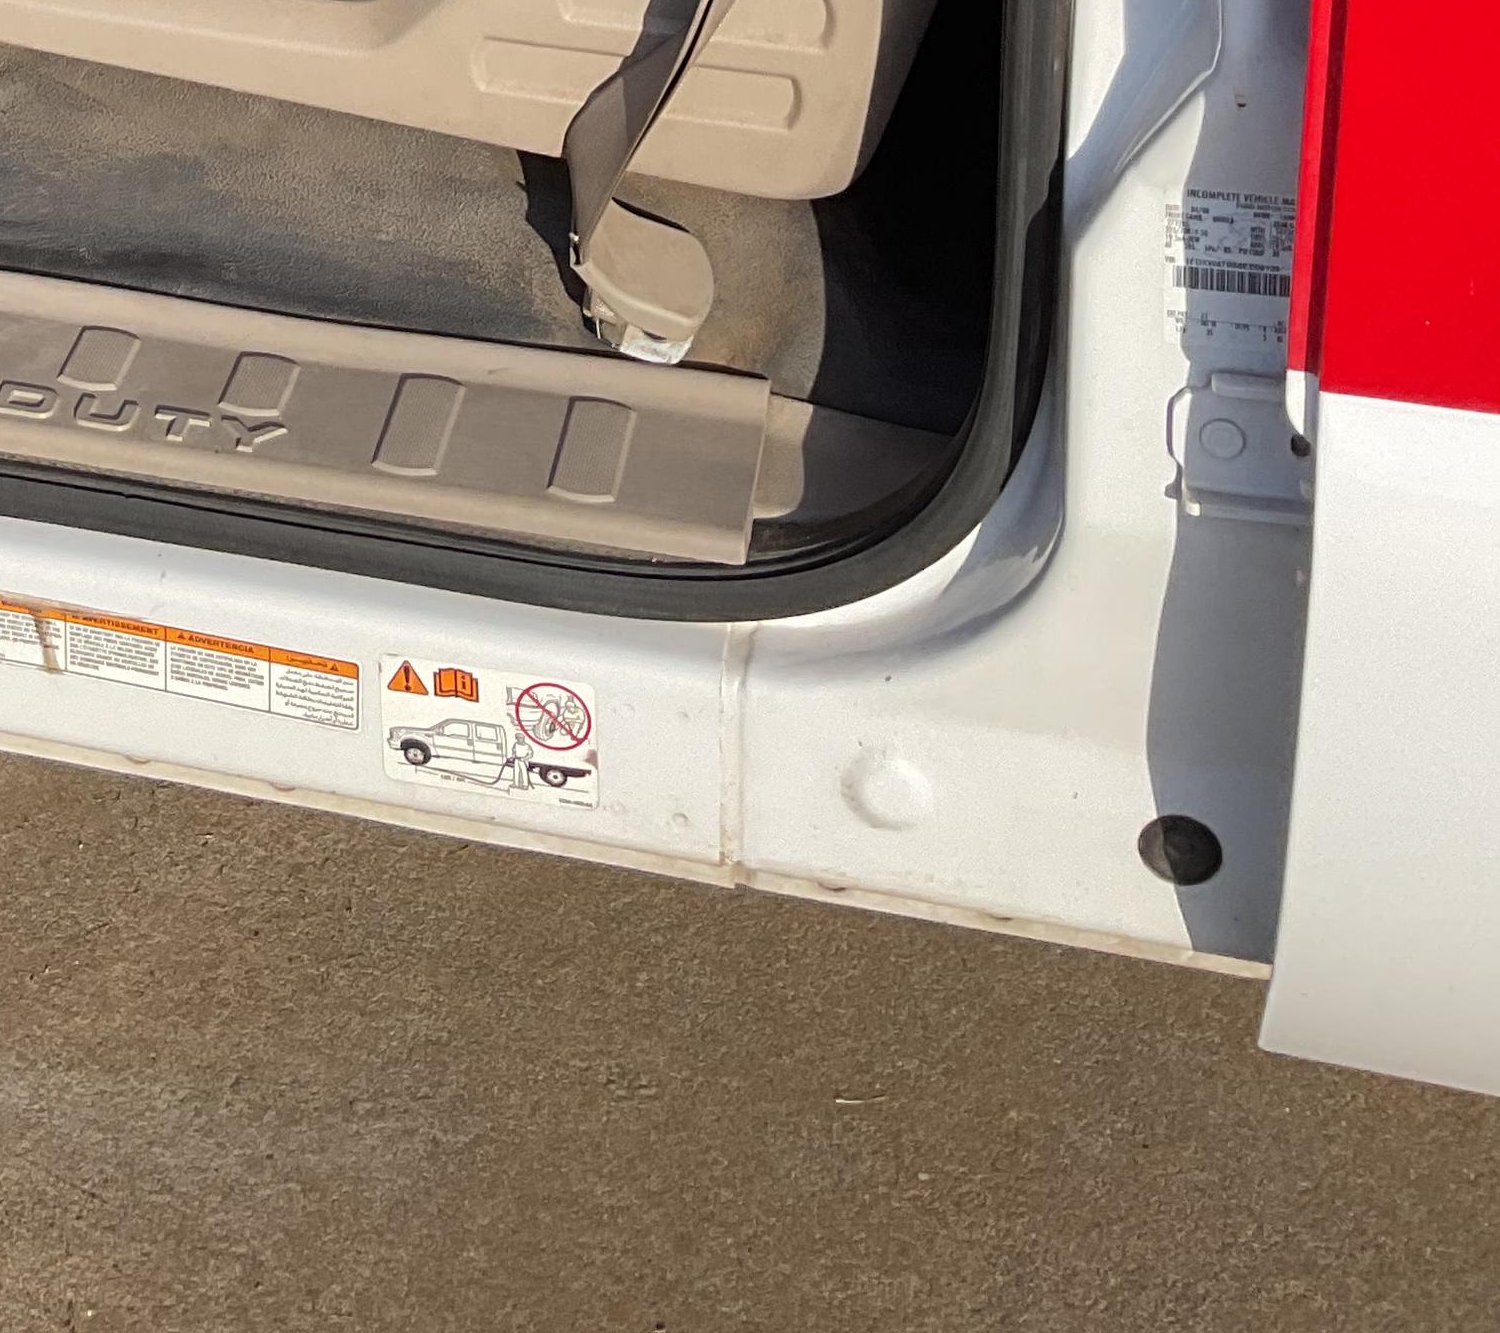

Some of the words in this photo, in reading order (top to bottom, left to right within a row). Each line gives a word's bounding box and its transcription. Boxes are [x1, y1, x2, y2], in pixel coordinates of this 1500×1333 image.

[1187, 189, 1239, 202] INCOMPLETE
[1243, 194, 1279, 204] VEHICLE
[188, 634, 255, 654] ADVERTENCIA
